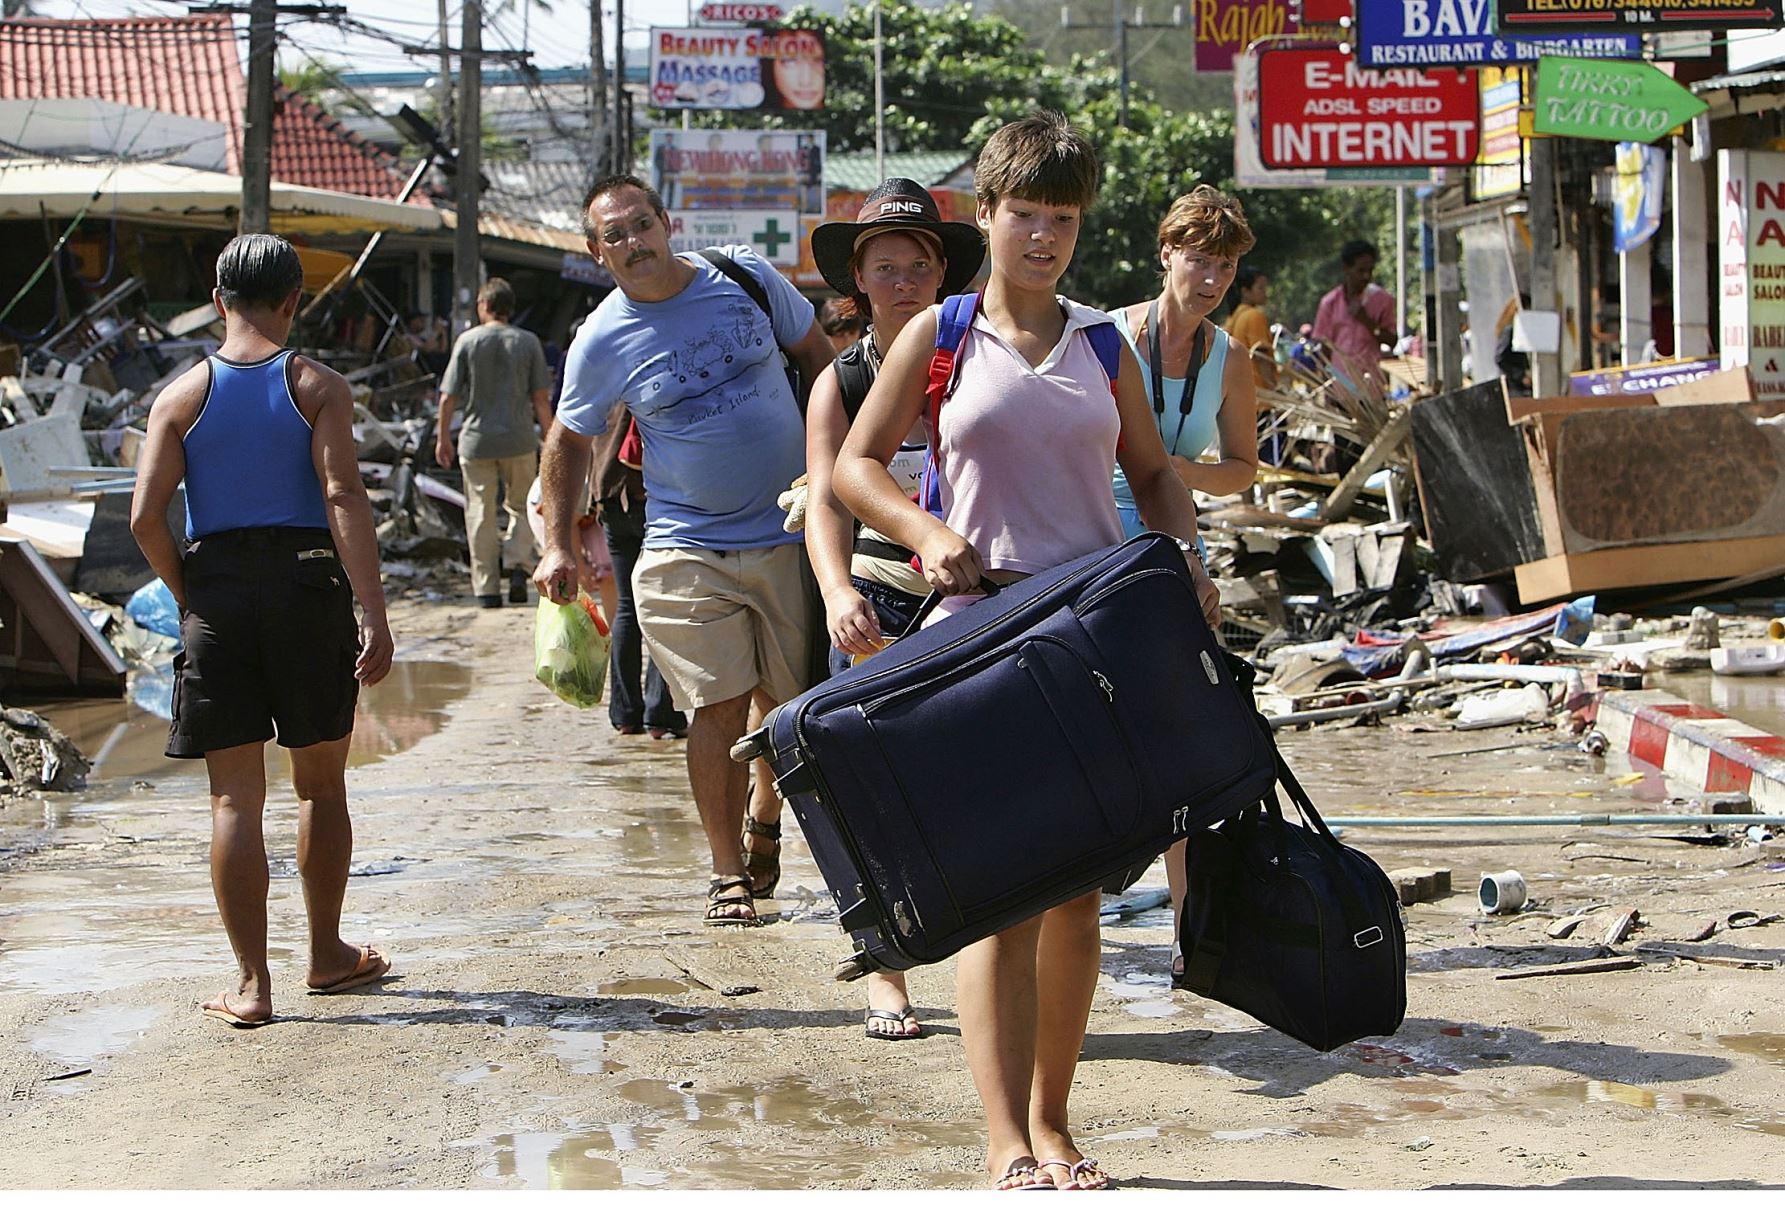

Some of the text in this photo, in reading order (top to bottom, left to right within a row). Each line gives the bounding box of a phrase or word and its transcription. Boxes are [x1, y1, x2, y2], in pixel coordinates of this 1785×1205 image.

[660, 33, 818, 57] BEAUTY SALON
[1372, 43, 1485, 64] RESTAURANT
[1491, 40, 1510, 60] &
[658, 61, 760, 83] MASSAGE
[1304, 98, 1441, 115] ADSL SPEED
[1547, 96, 1668, 132] TATTOO
[1272, 121, 1474, 162] INTERNET
[880, 201, 924, 214] PING
